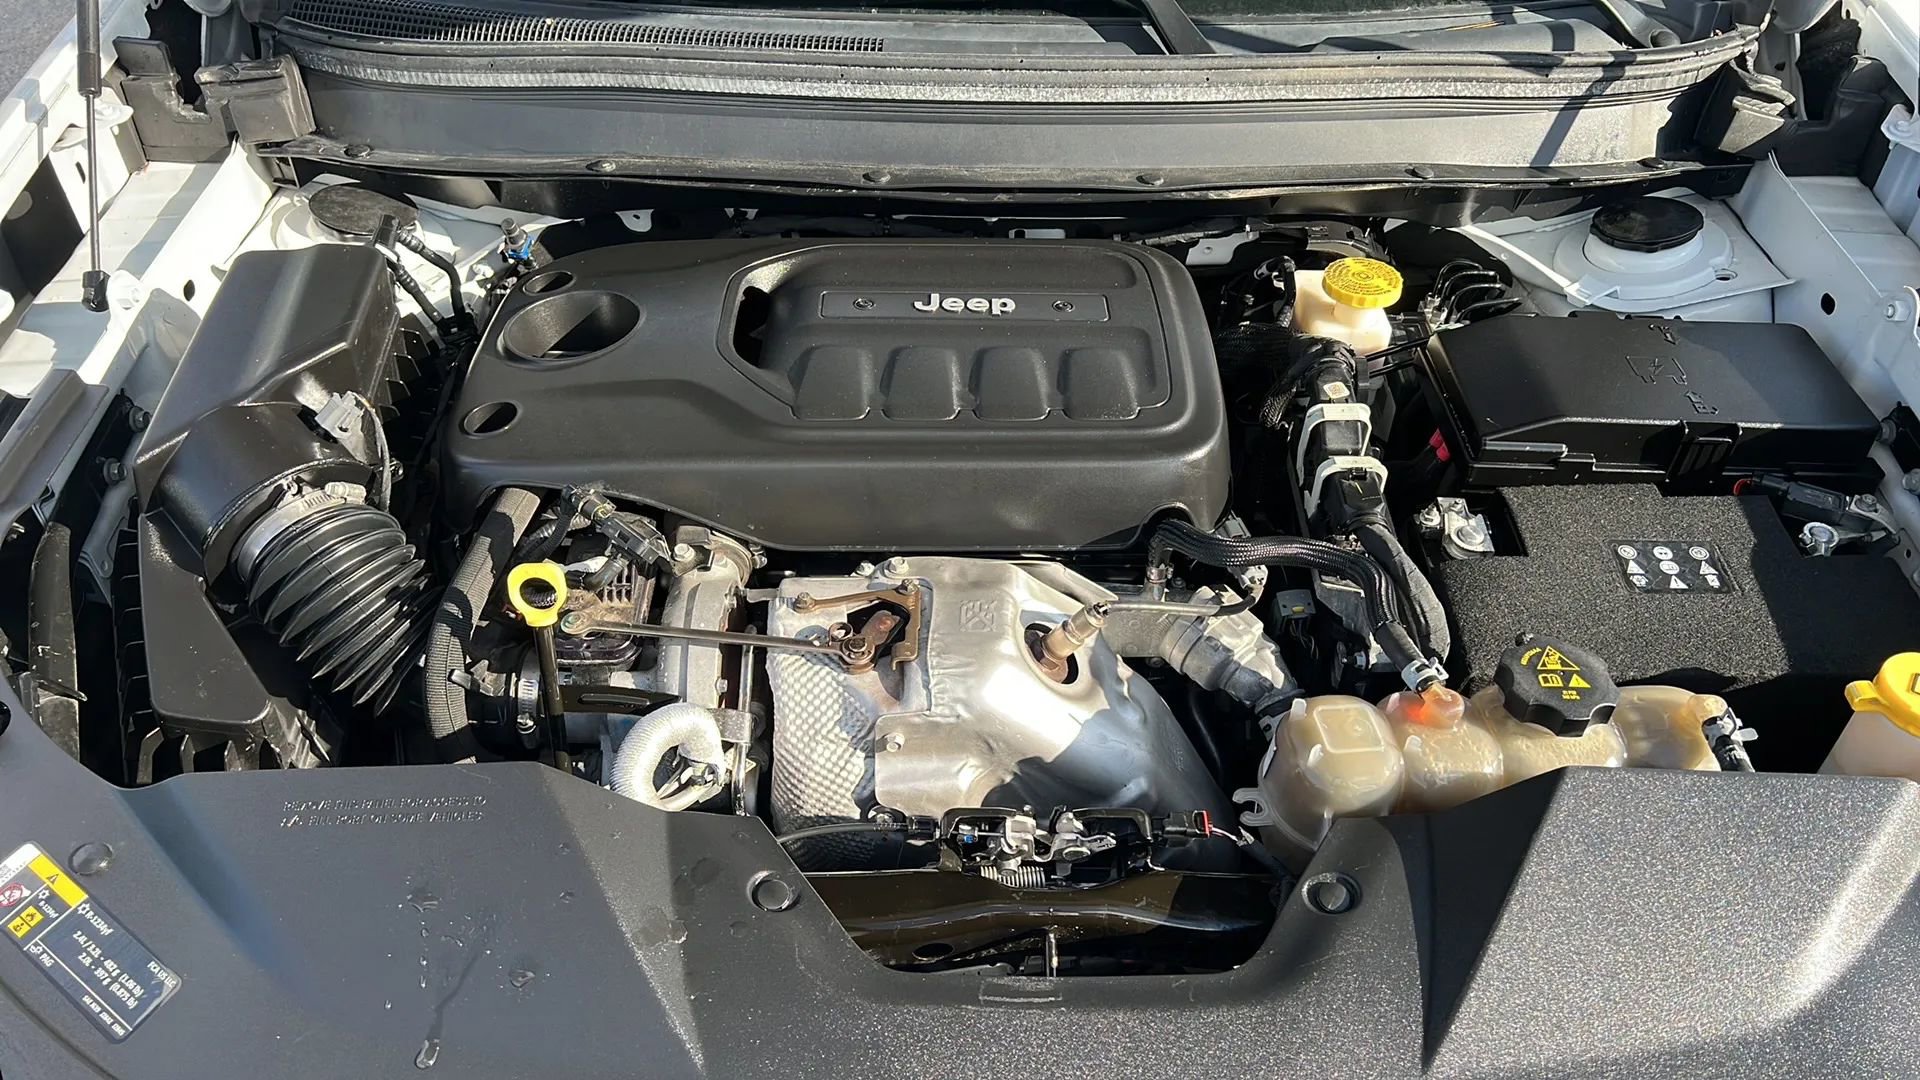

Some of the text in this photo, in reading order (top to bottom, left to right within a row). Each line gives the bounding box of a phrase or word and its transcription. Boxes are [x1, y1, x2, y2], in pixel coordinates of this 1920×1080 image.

[913, 293, 1016, 316] Jeep
[473, 795, 487, 806] TO
[85, 909, 114, 936] R-1234yf
[39, 952, 55, 967] PAG
[146, 960, 177, 988] FCA US LLC
